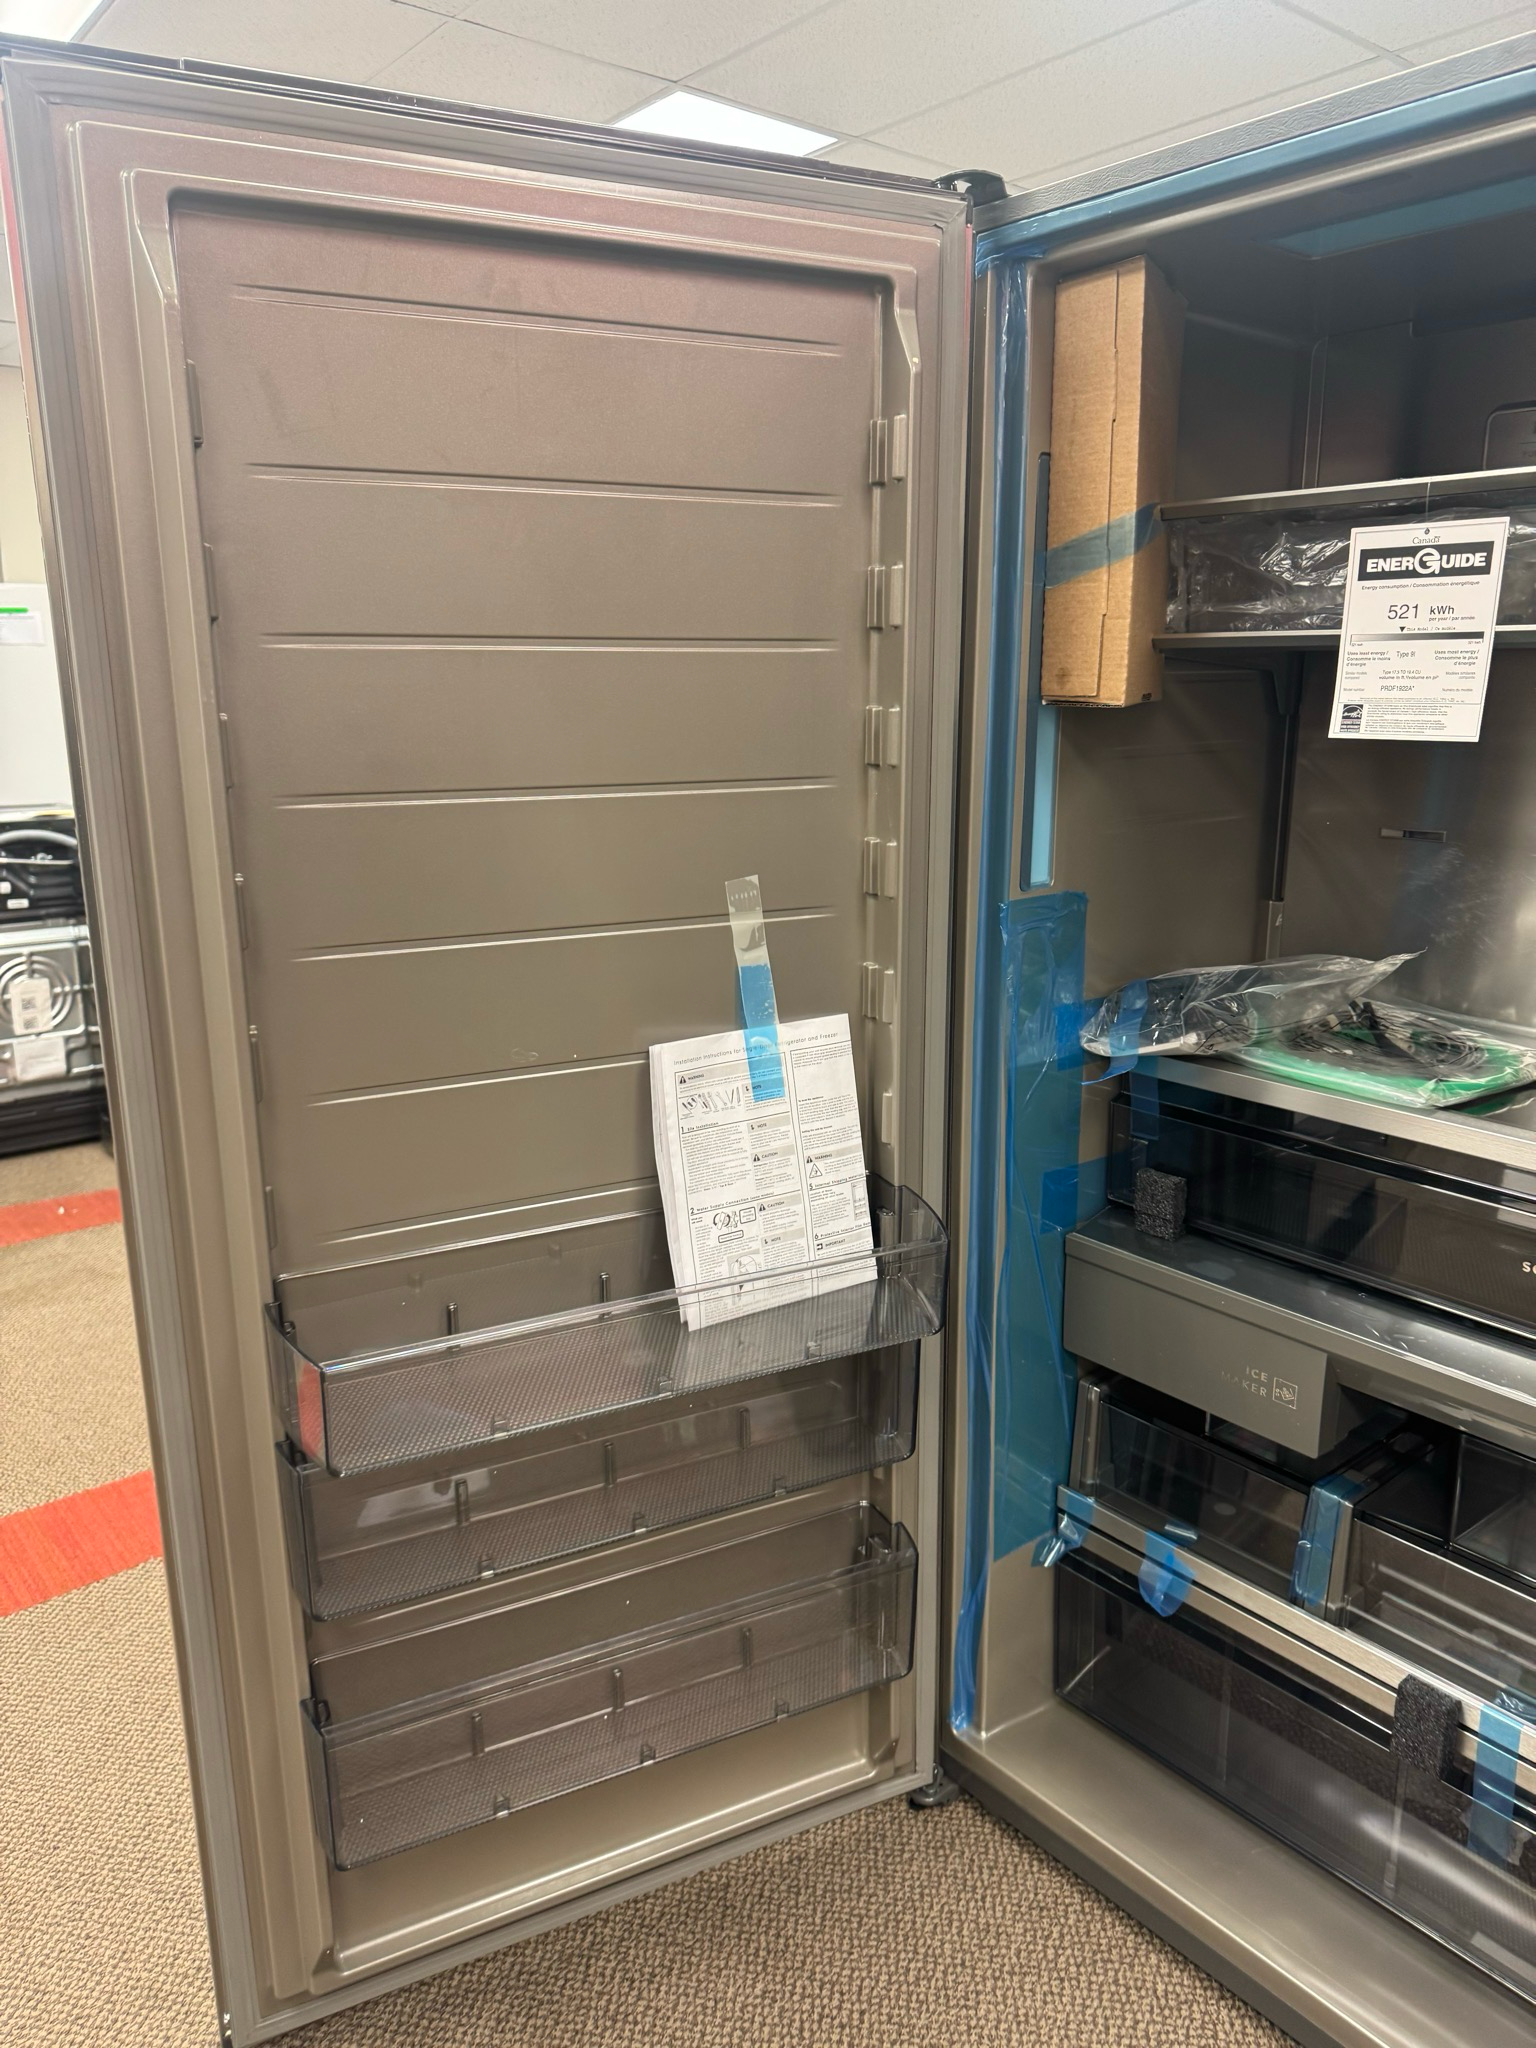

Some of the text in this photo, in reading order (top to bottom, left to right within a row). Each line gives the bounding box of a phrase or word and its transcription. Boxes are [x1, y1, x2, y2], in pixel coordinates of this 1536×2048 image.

[1412, 536, 1441, 544] Canada
[1366, 548, 1488, 574] ENERGUIDE
[1362, 583, 1378, 591] Energy
[1379, 582, 1409, 590] consumption
[1413, 580, 1449, 588] Consommation
[1387, 603, 1455, 620] 521 kWh
[1396, 651, 1408, 659] Type
[673, 1056, 702, 1066] Installation
[703, 1050, 732, 1060] Instructions
[774, 1038, 808, 1048] Rrigerator
[820, 1032, 840, 1040] Freezer
[725, 1197, 749, 1206] Connection
[825, 1239, 846, 1247] IMPORTANT
[1246, 1365, 1268, 1383] ICE
[1221, 1370, 1267, 1398] MAKER
